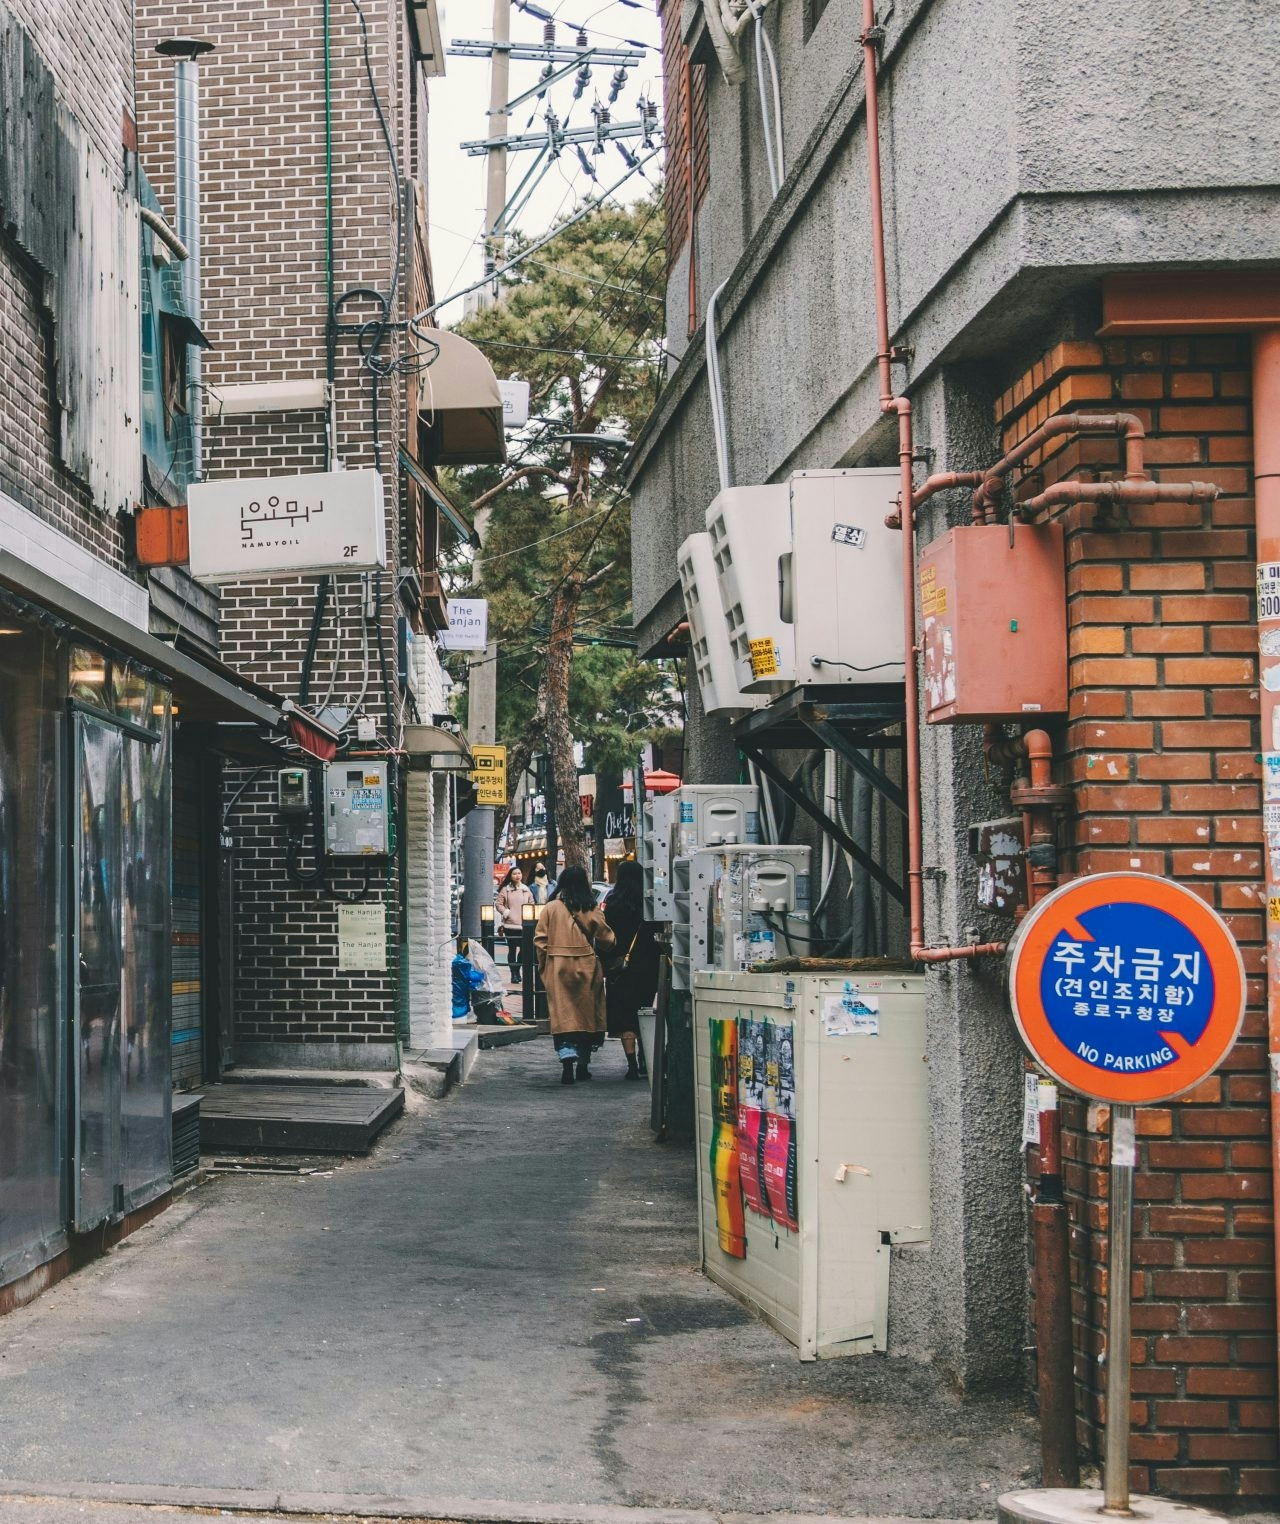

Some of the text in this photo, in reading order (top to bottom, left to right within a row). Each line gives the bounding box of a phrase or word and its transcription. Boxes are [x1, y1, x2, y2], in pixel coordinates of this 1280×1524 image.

[242, 539, 300, 548] NAMUYOIL
[343, 545, 358, 557] 2F
[452, 606, 473, 615] The
[449, 618, 481, 627] anjan
[477, 790, 503, 798] 인단속중
[1053, 941, 1201, 985] 주차금지
[1054, 977, 1195, 1007] (견인조치함)
[1072, 1002, 1175, 1023] 종로구청장
[1077, 1041, 1173, 1071] NO PARKING
